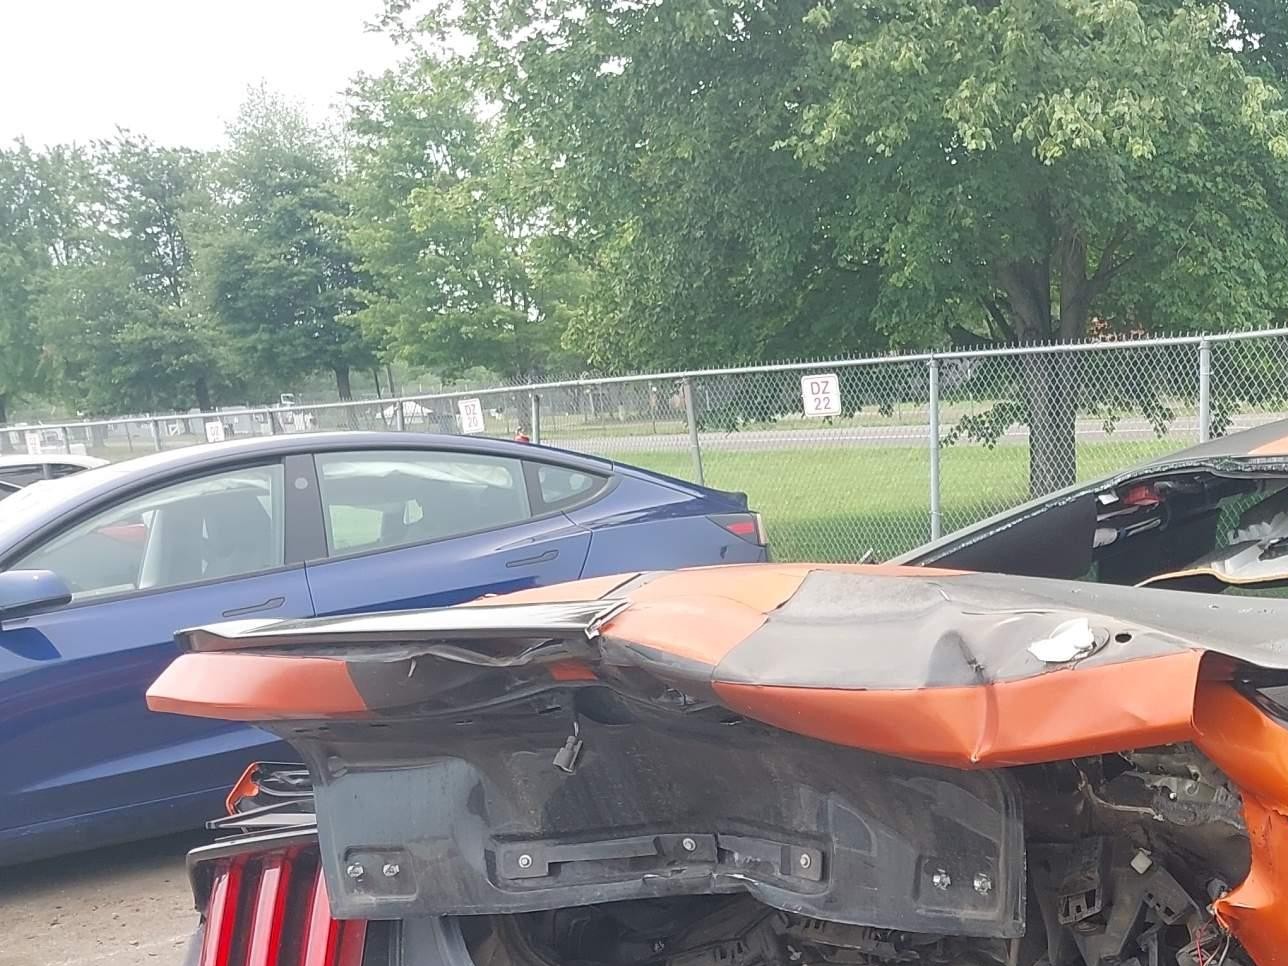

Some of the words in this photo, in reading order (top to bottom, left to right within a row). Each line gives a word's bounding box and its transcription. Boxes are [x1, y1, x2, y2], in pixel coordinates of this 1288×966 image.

[810, 381, 831, 395] DZ
[464, 403, 478, 416] DZ
[814, 396, 831, 411] 22
